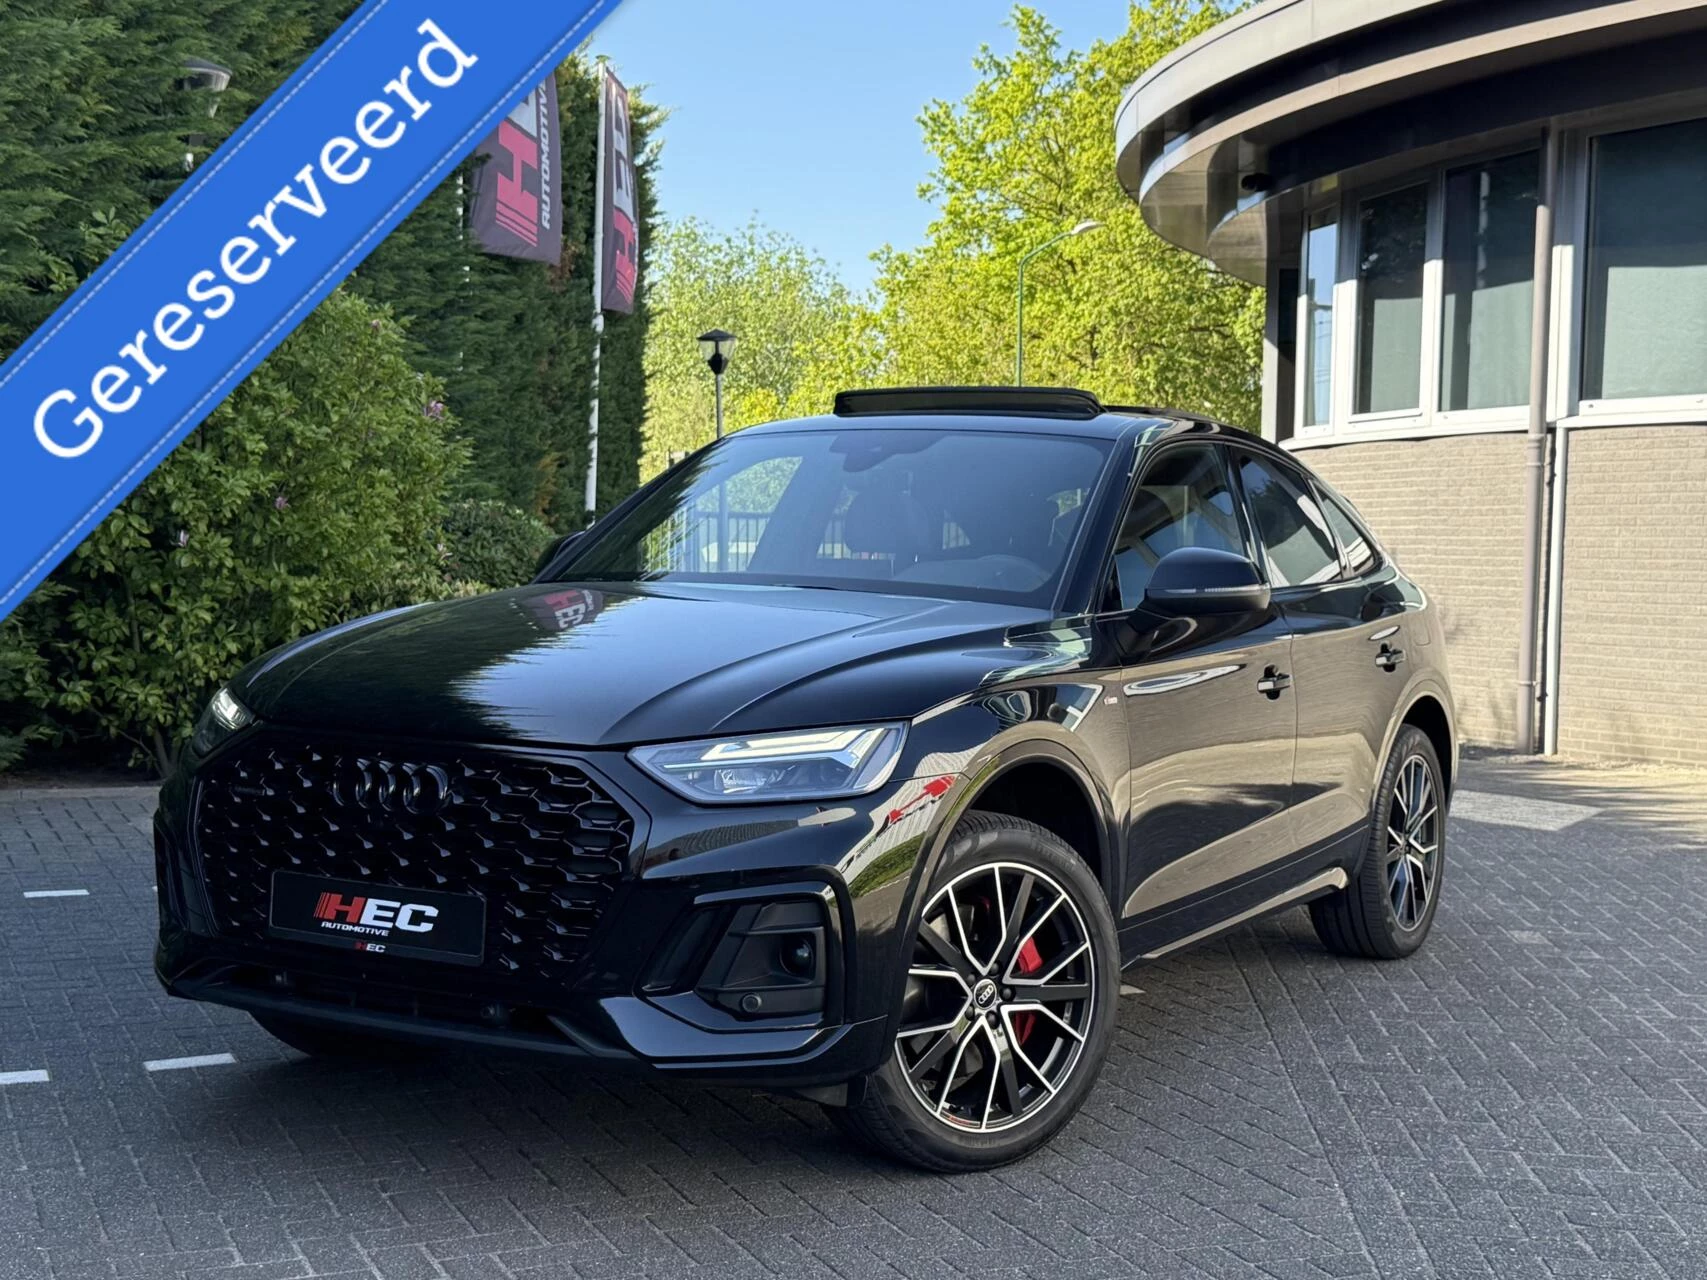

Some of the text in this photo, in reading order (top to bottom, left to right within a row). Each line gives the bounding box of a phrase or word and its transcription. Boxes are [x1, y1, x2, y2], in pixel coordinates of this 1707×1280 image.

[314, 892, 439, 933] HEC
[321, 921, 390, 937] AUTOMOTIVE
[355, 942, 386, 953] HEC
